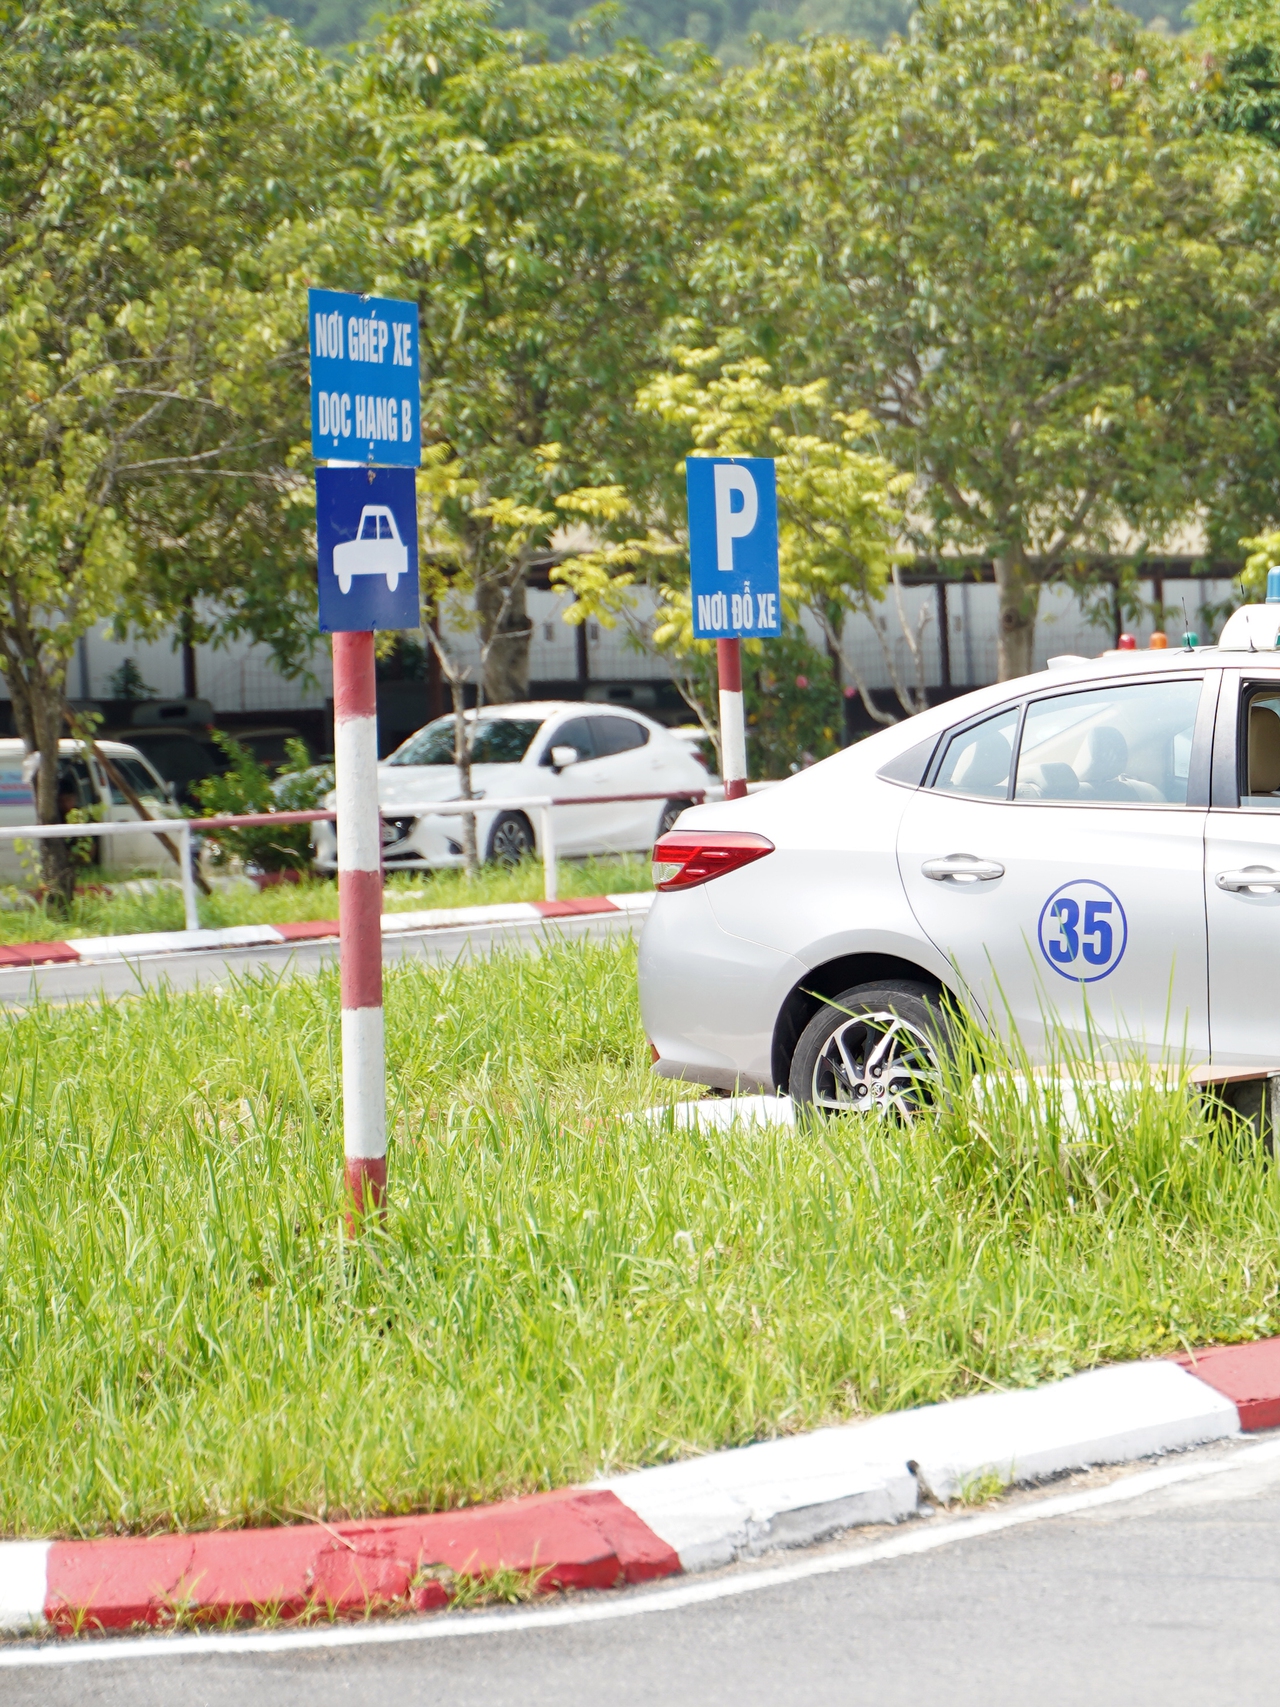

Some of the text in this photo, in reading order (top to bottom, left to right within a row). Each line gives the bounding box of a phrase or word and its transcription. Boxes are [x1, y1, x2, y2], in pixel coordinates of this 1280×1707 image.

[315, 310, 412, 367] NƠI GHÉP XE
[318, 391, 412, 449] DỌC HẠNG B
[713, 464, 759, 571] P
[697, 580, 777, 631] NƠI ĐỖ XE
[1049, 898, 1113, 965] 35
